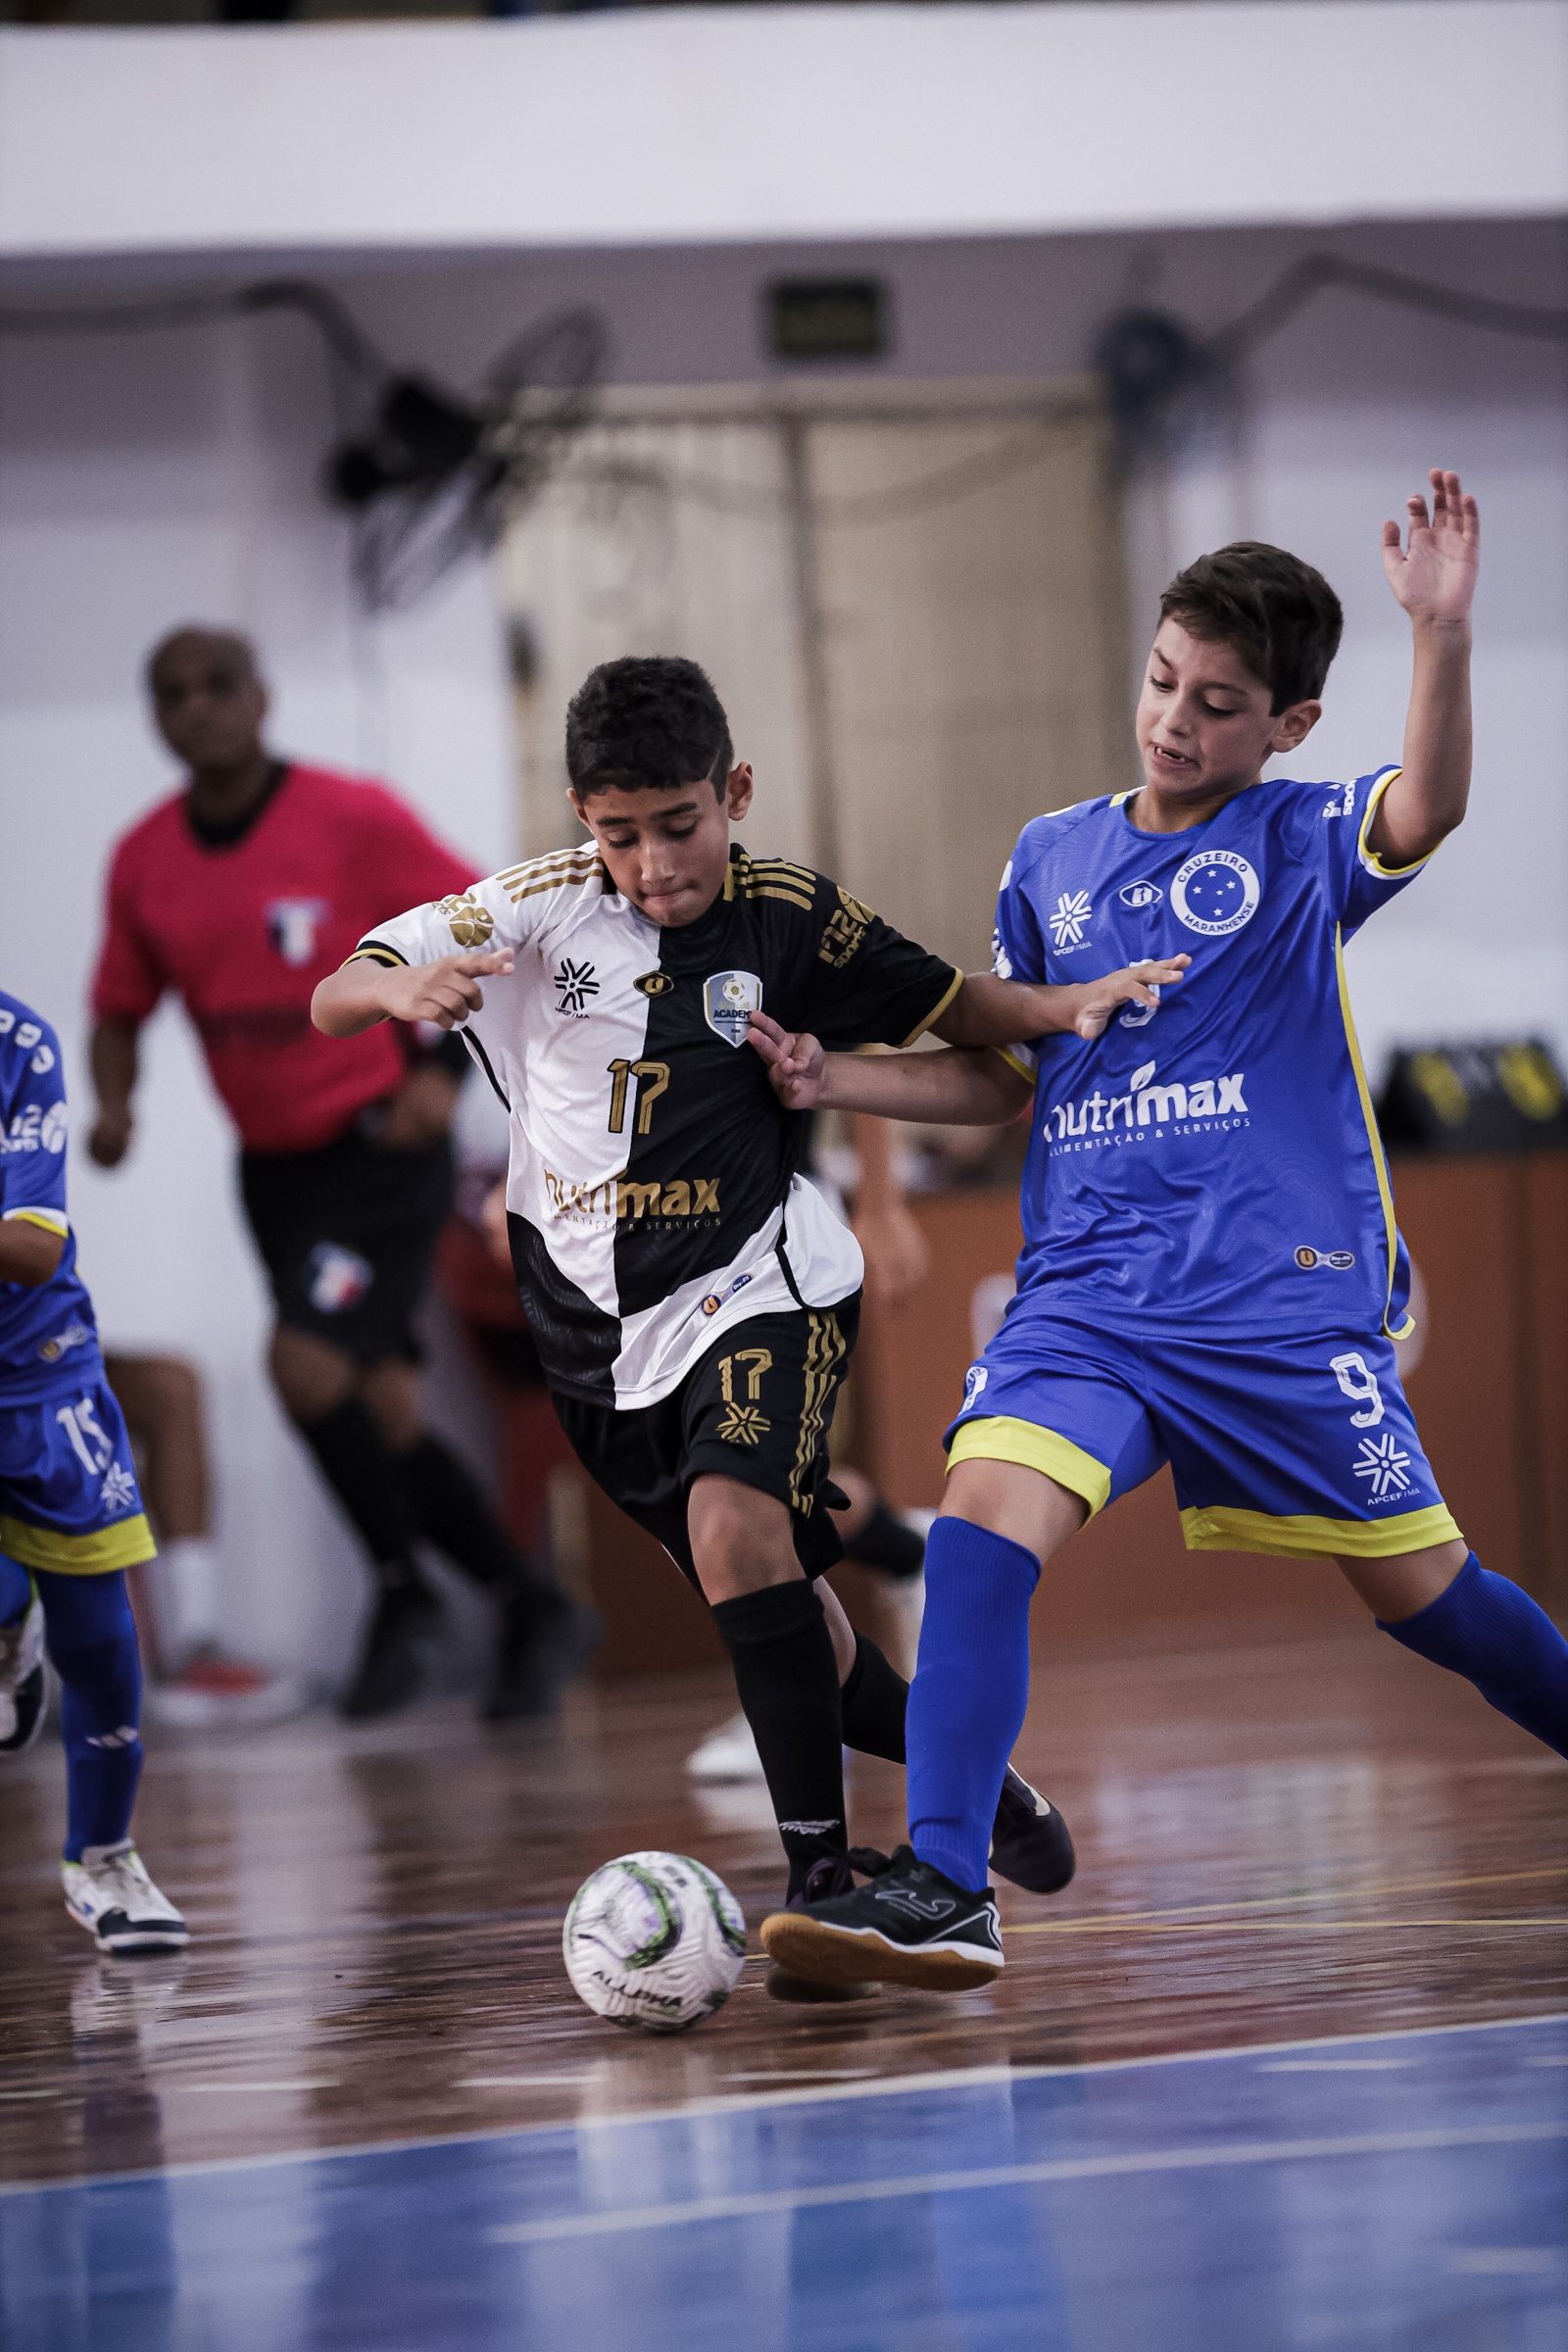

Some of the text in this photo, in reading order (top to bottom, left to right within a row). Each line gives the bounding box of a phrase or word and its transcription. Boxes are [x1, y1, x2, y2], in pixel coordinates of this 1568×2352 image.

[1178, 853, 1248, 883] CRUZEIRO
[1184, 901, 1254, 933] MARANHENSE
[713, 1009, 753, 1019] ACADEM
[607, 1058, 670, 1135] 17
[1043, 1060, 1249, 1143] nutrimax
[1155, 1128, 1164, 1139] &
[1174, 1117, 1251, 1136] SERVIÇOS
[545, 1168, 721, 1219] nutrimax
[718, 1348, 773, 1402] 17
[1329, 1351, 1386, 1429] 9
[56, 1396, 115, 1476] 15
